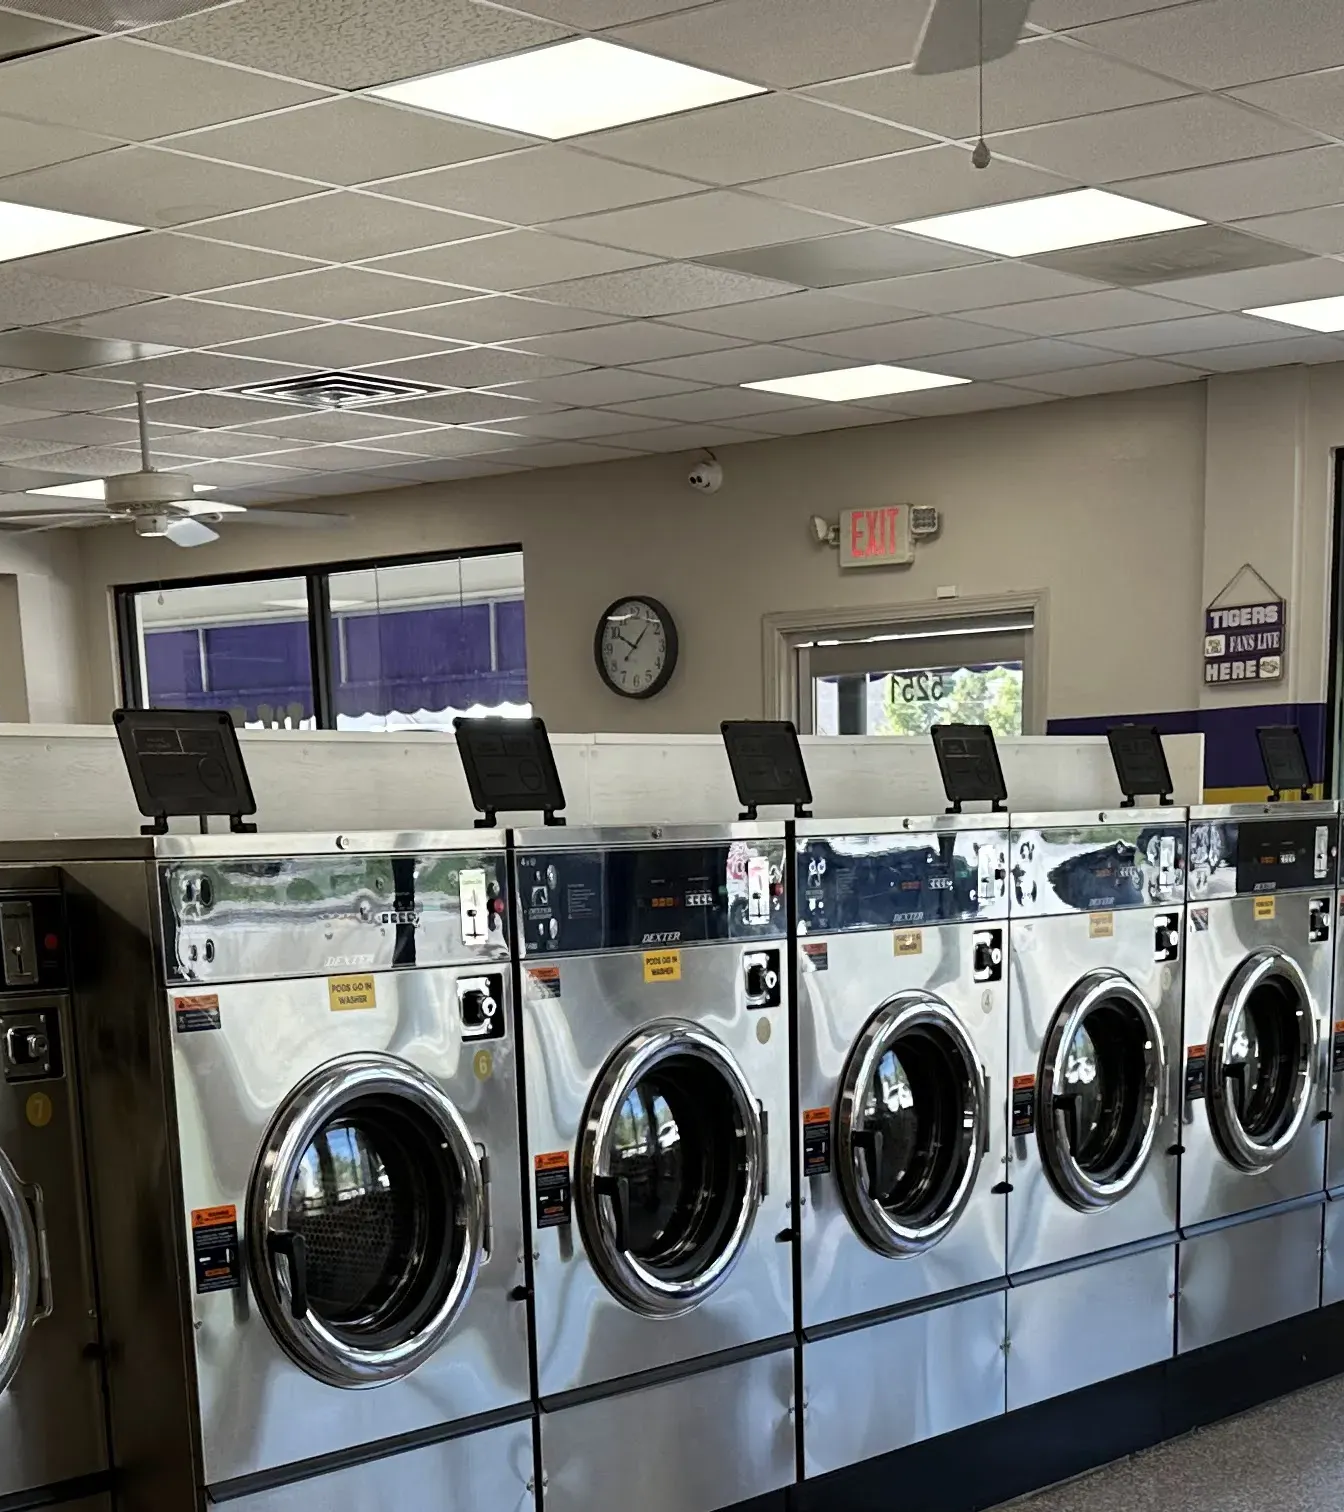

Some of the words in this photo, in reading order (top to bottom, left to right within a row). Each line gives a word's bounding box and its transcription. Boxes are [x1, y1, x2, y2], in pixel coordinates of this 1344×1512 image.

[851, 508, 899, 557] EXIT
[1210, 605, 1278, 629] TIGERS
[611, 626, 620, 639] 10
[653, 623, 661, 635] 2
[659, 639, 665, 652] 3
[1229, 634, 1255, 652] FANS
[1257, 631, 1280, 650] LIVE
[645, 670, 652, 682] 5
[1205, 660, 1256, 681] HERE
[620, 671, 627, 684] 7
[633, 675, 640, 687] 6
[642, 931, 680, 943] DEXTER
[332, 984, 351, 993] PODS
[352, 982, 364, 991] GO
[365, 982, 372, 991] IN
[338, 995, 367, 1005] WASHER
[479, 1055, 487, 1074] 6
